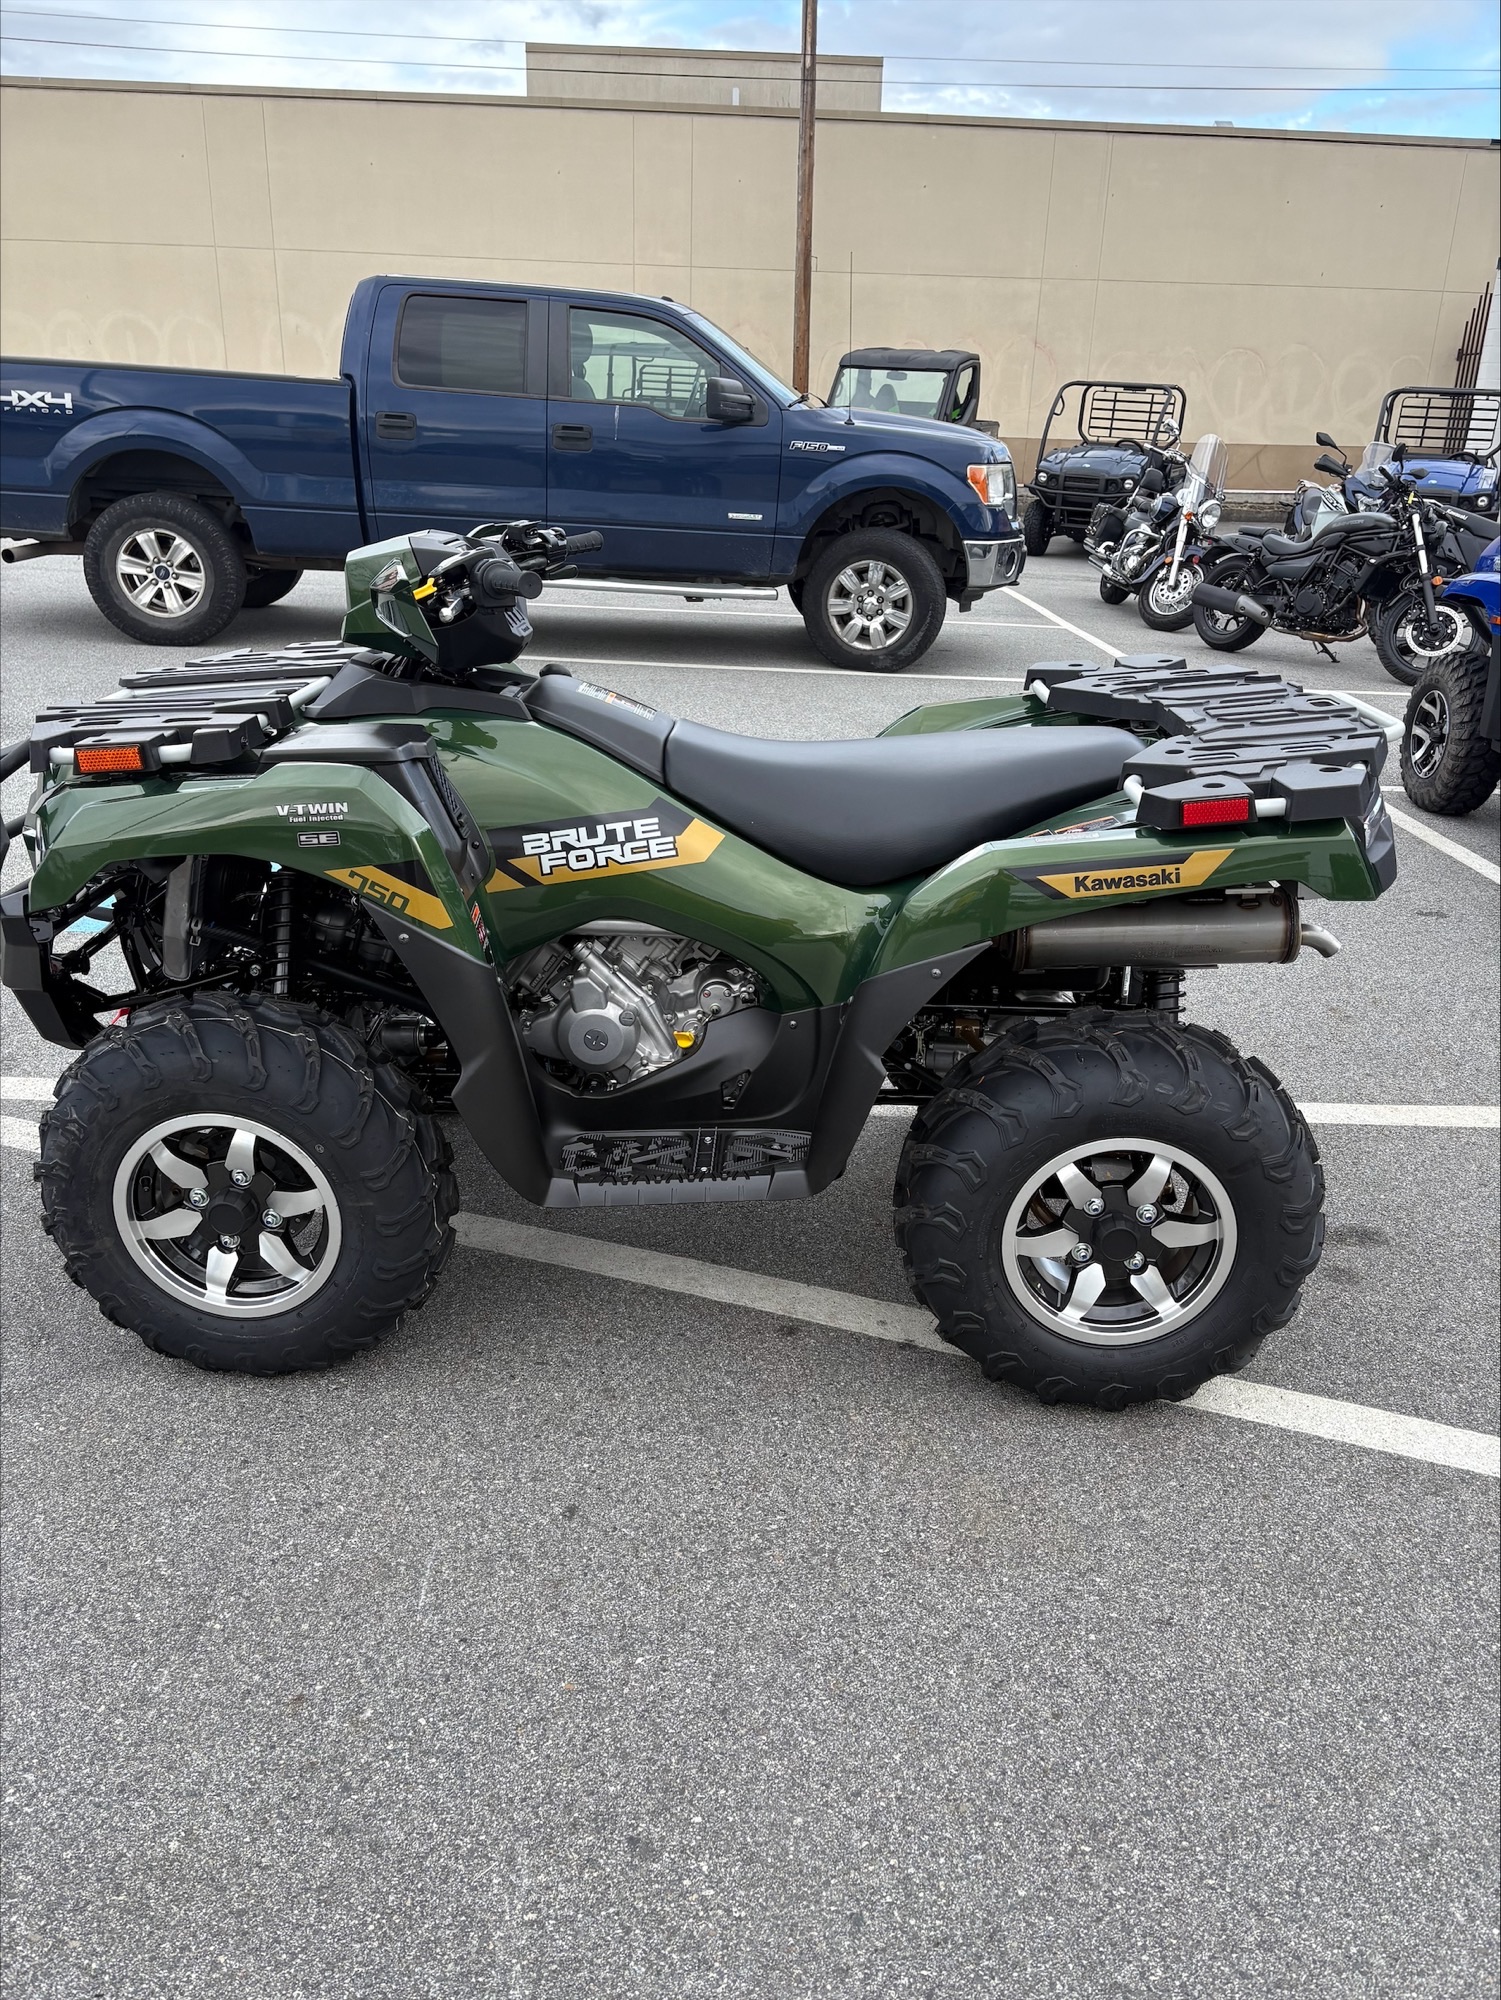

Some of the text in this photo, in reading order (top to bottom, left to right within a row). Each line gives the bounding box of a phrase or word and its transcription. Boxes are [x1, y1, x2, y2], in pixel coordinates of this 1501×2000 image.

[29, 407, 73, 415] ROAD
[275, 802, 349, 816] V-TWIN
[309, 814, 344, 822] Injected
[299, 833, 338, 845] SE
[521, 817, 662, 856] BRUTE
[540, 836, 677, 875] FORCE
[1074, 867, 1181, 893] Kawasaki
[348, 869, 410, 914] 750
